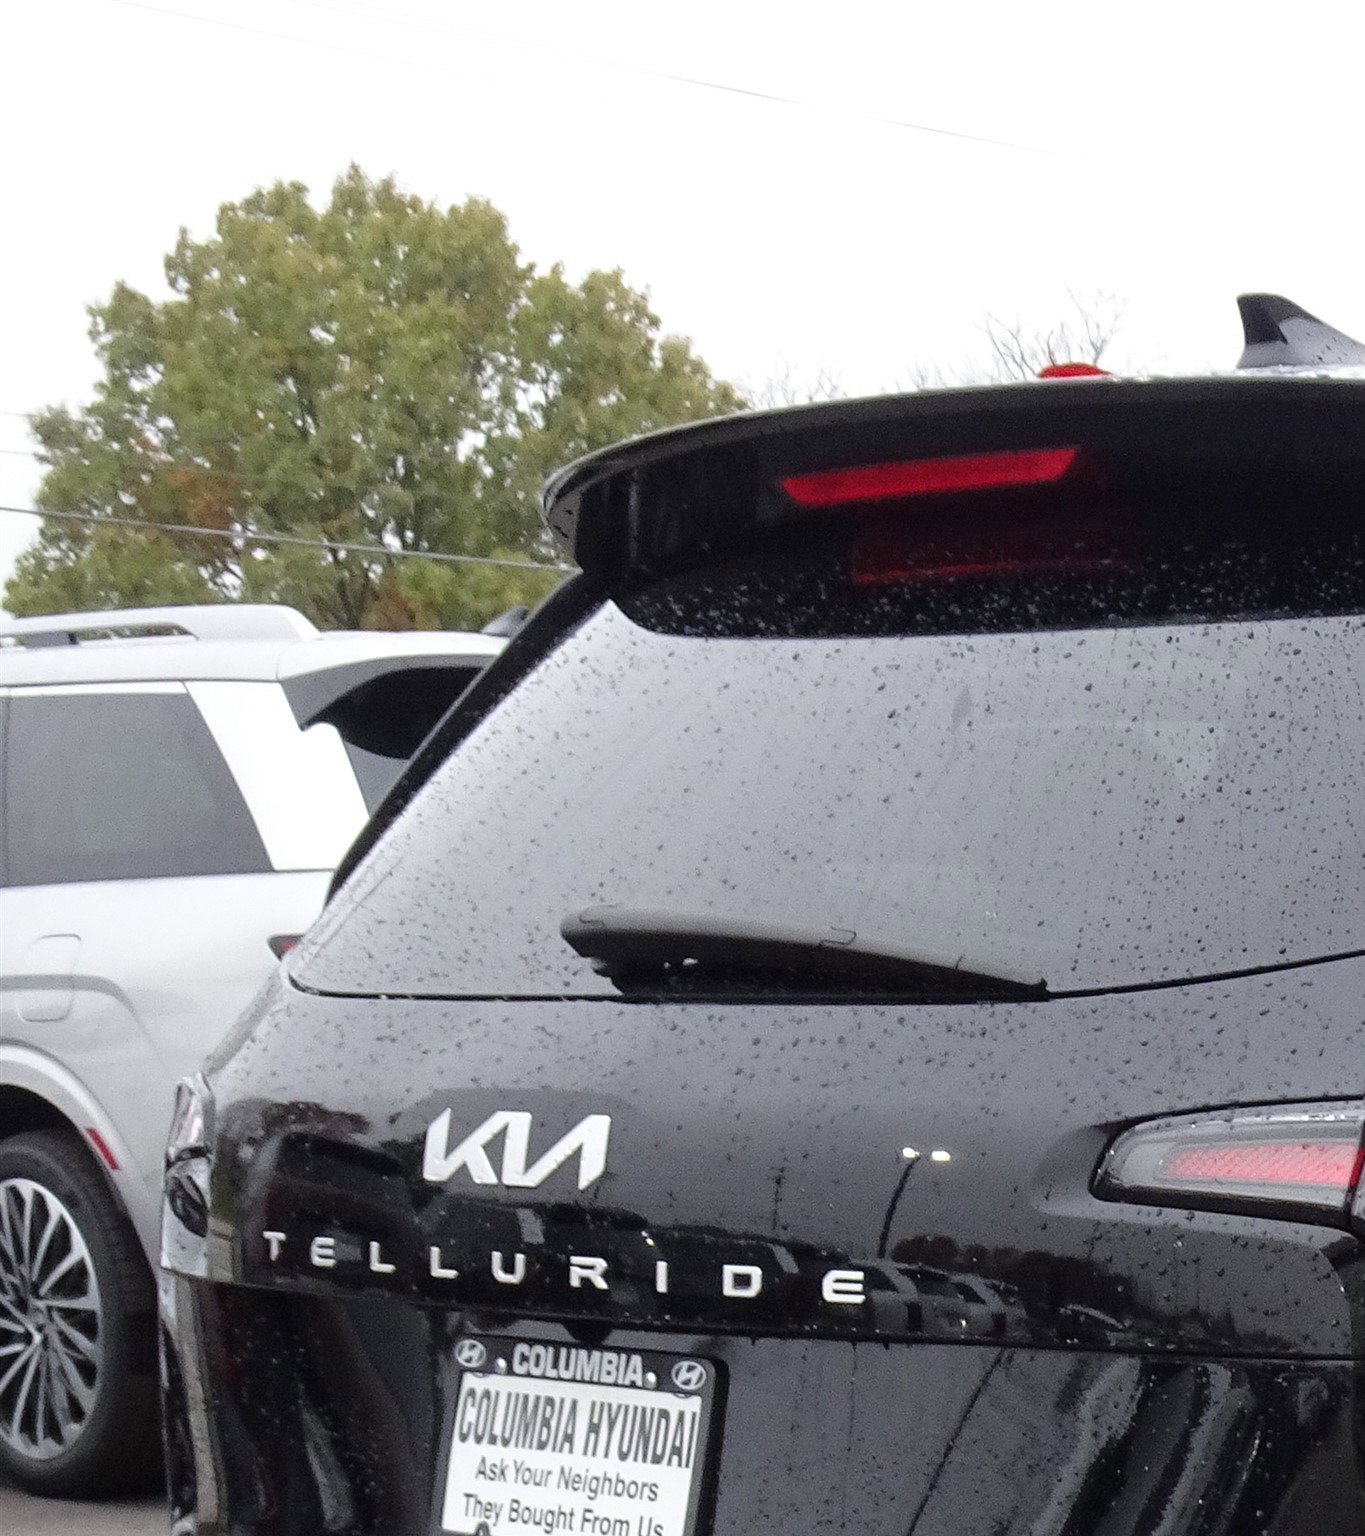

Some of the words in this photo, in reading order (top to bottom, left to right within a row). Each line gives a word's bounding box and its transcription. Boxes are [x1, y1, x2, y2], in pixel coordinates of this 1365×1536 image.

[423, 1107, 611, 1191] KIA
[262, 1231, 866, 1304] TELLURIDE
[512, 1343, 644, 1387] COLUMBIA
[458, 1387, 578, 1455] COLUMBIA
[583, 1400, 698, 1469] HYUNDAI
[475, 1456, 508, 1482] Ask
[513, 1458, 552, 1487] Your
[557, 1465, 659, 1501] Neighbors
[463, 1493, 503, 1527] They
[508, 1499, 574, 1535] Bought
